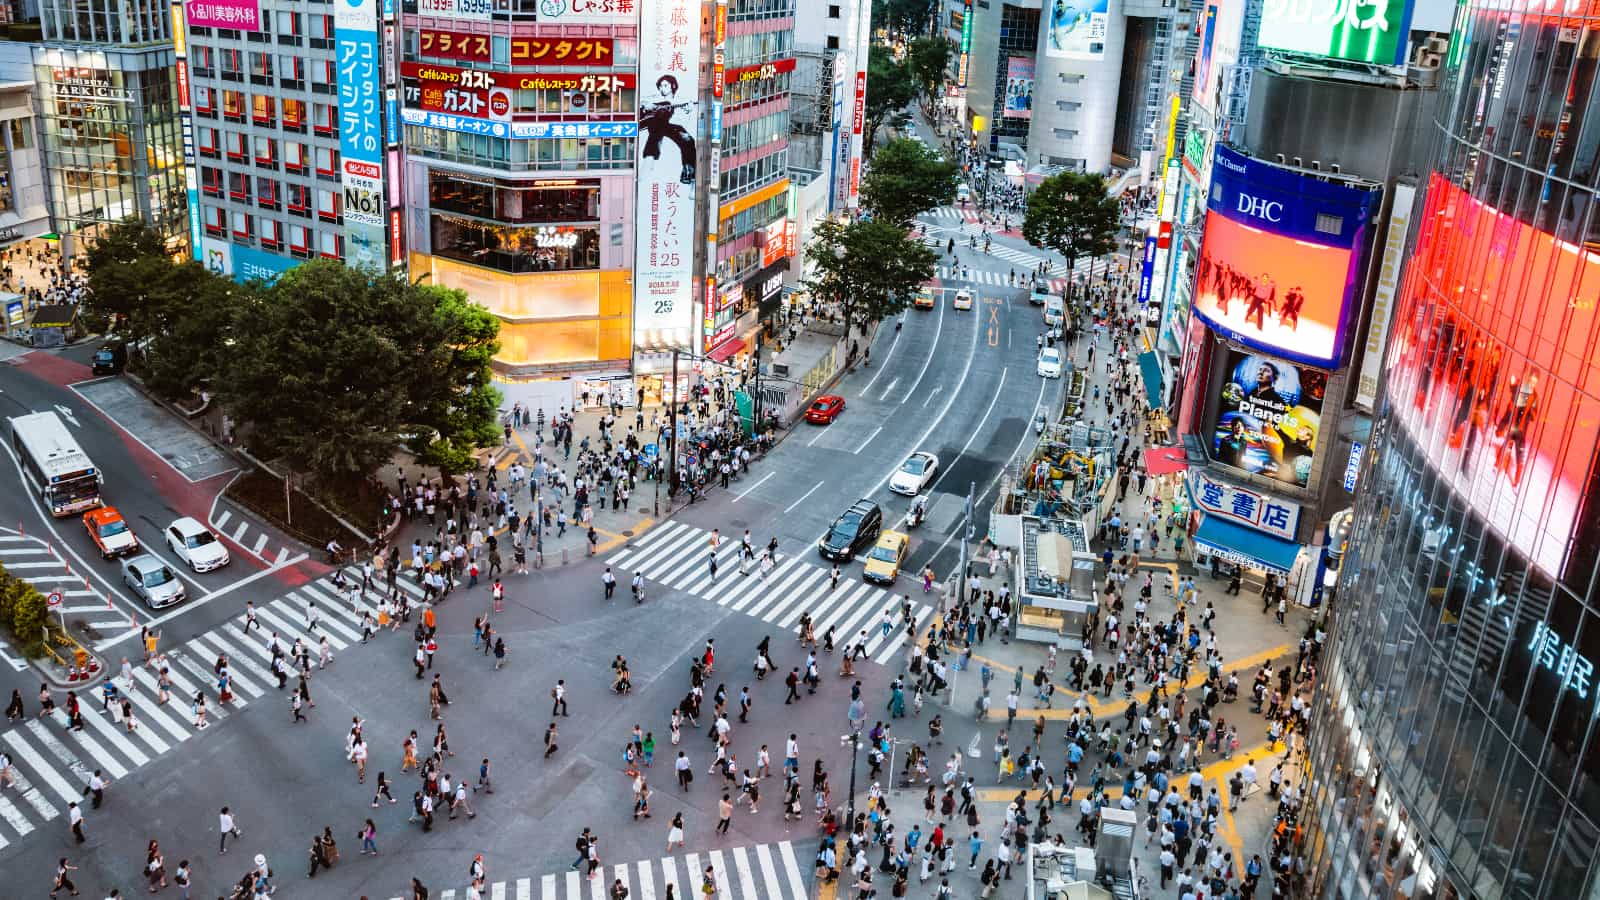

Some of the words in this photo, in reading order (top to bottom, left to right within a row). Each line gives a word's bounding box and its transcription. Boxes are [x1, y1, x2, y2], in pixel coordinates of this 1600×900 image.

[512, 41, 610, 59] コンタクト
[460, 70, 495, 89] ガスト
[580, 75, 625, 92] ガスト
[340, 41, 359, 149] アイシティ
[360, 42, 377, 152] コンタクトの
[406, 87, 420, 100] 7F
[444, 89, 486, 113] ガスト
[552, 125, 636, 137] 英会話イーオン
[344, 187, 382, 217] No.1
[1237, 192, 1283, 222] DHC
[763, 271, 783, 297] LUSH
[1231, 332, 1245, 342] DHC
[1238, 400, 1298, 428] Planets
[1201, 482, 1290, 529] 堂書店
